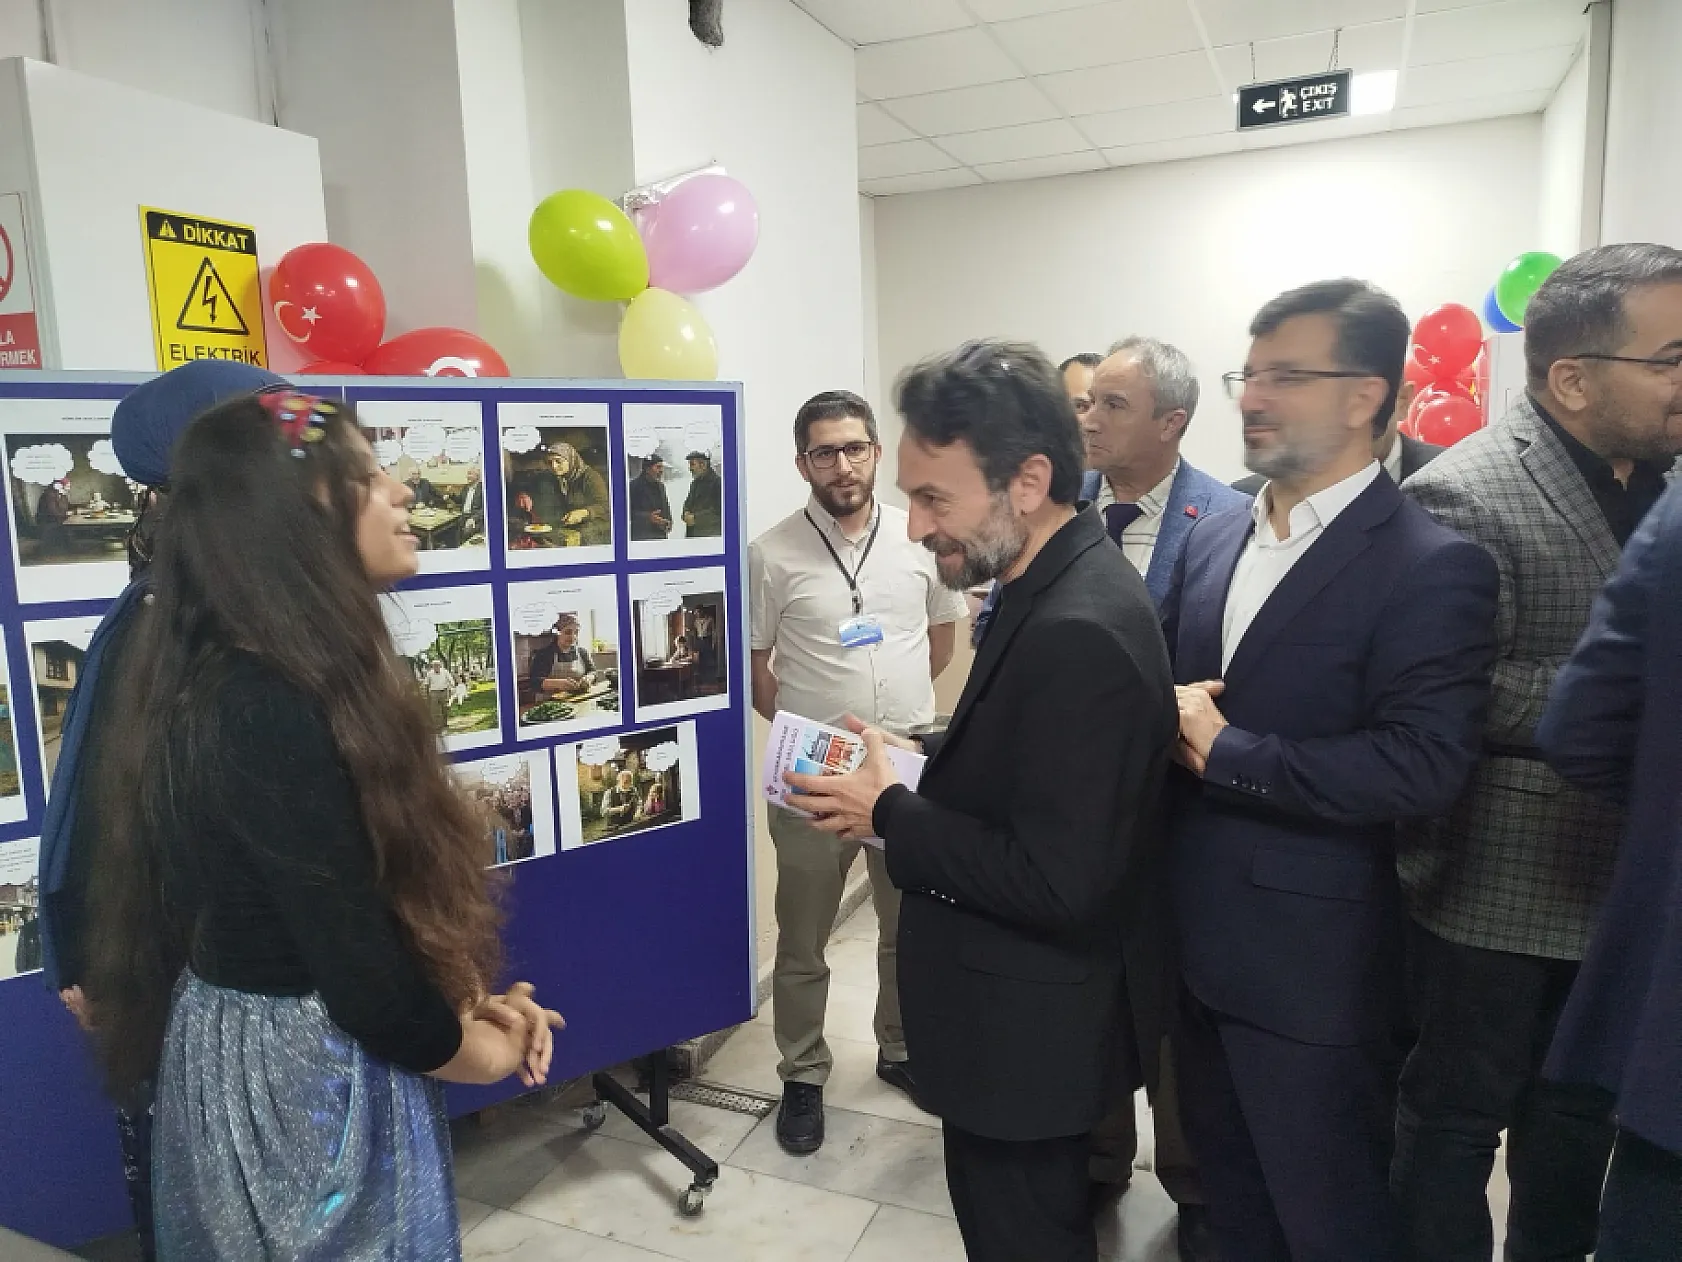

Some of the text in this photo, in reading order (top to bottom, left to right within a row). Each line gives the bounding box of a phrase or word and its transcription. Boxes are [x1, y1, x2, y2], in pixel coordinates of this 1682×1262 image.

[1303, 98, 1335, 113] EXIT
[184, 222, 249, 251] DİKKAT
[169, 343, 262, 367] ELEKTRİK
